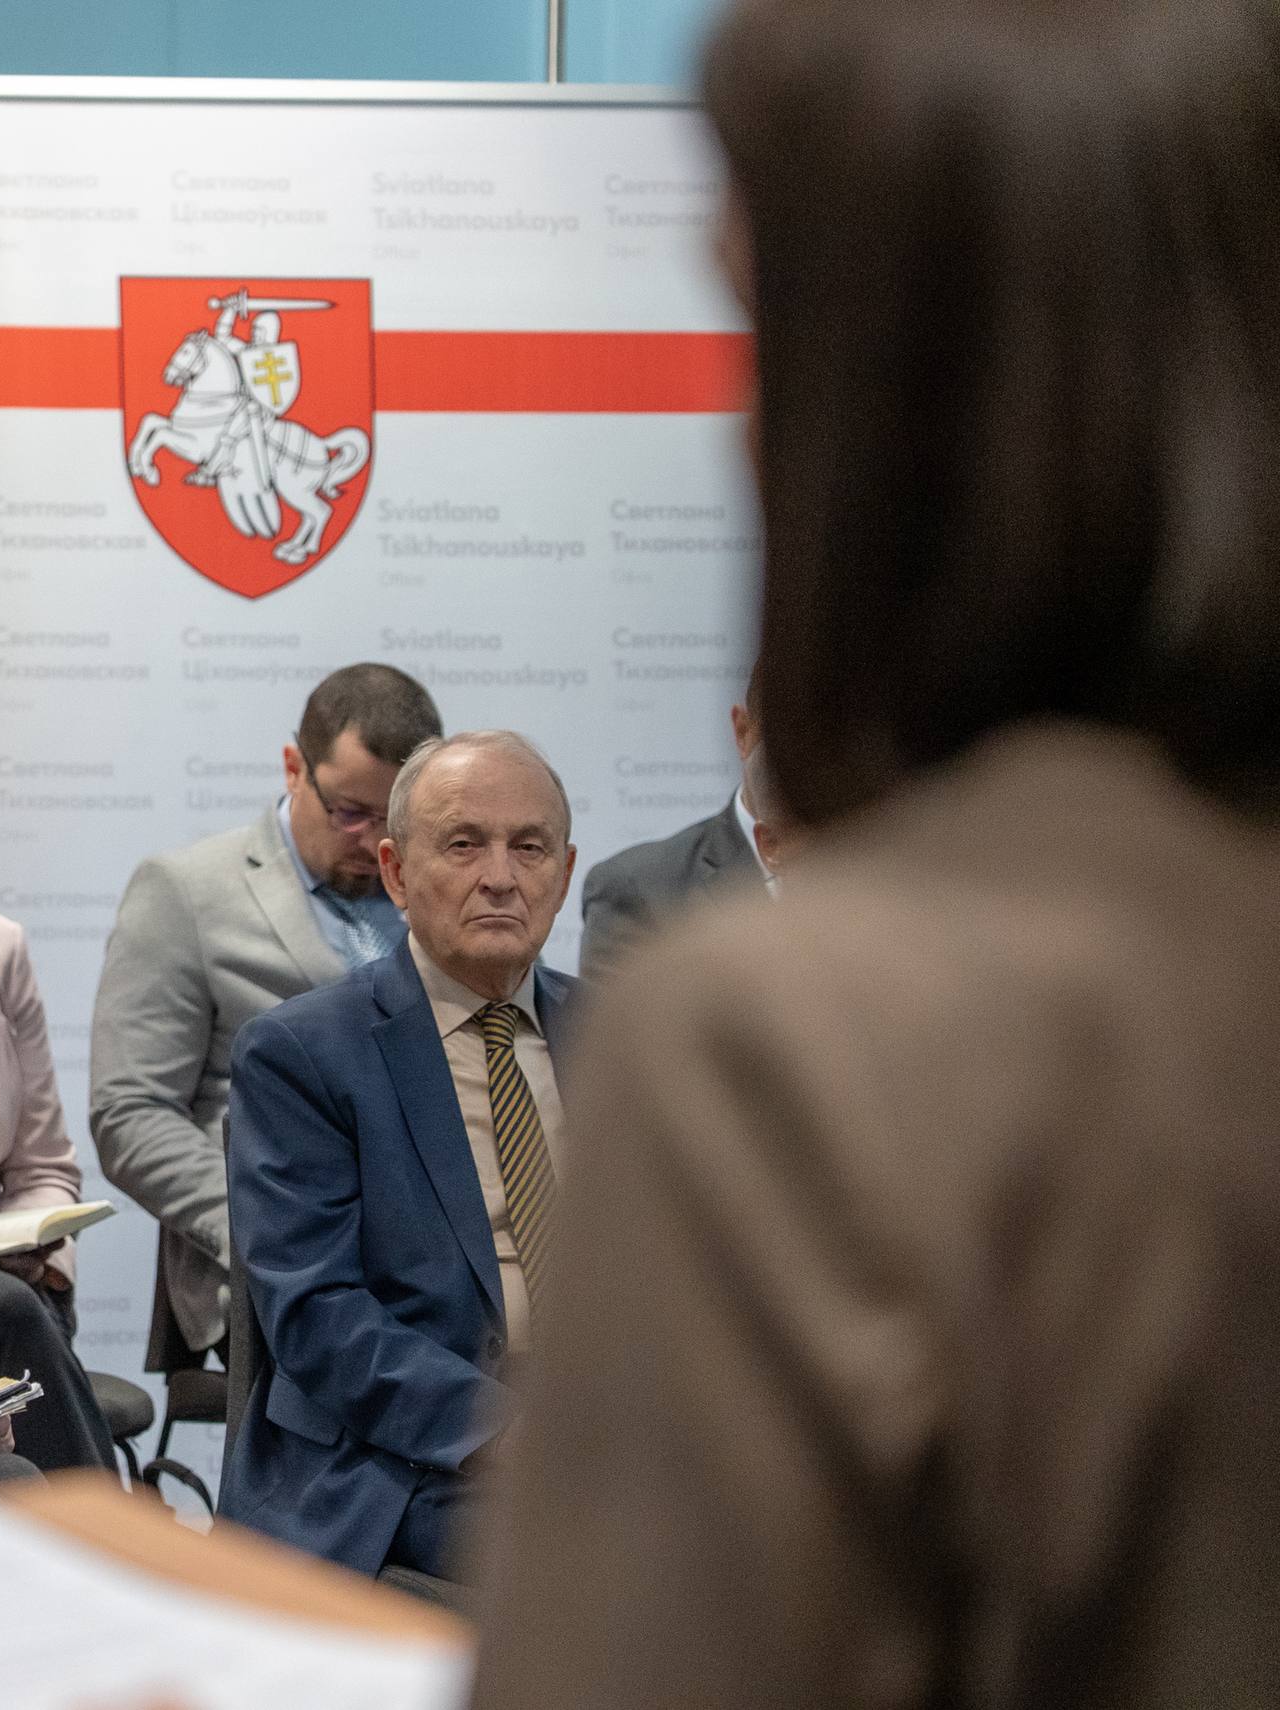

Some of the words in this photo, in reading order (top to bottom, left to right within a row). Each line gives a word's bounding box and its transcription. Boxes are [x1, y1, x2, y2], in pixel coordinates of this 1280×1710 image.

[372, 171, 495, 196] Sviatlana
[372, 205, 580, 236] Tsikhanouskaya
[377, 498, 501, 523] Sviatlana
[609, 499, 725, 521] Светлана
[378, 533, 586, 563] Tsikhanouskaya
[380, 628, 503, 652] Sviatlana
[611, 627, 727, 649] Светлана
